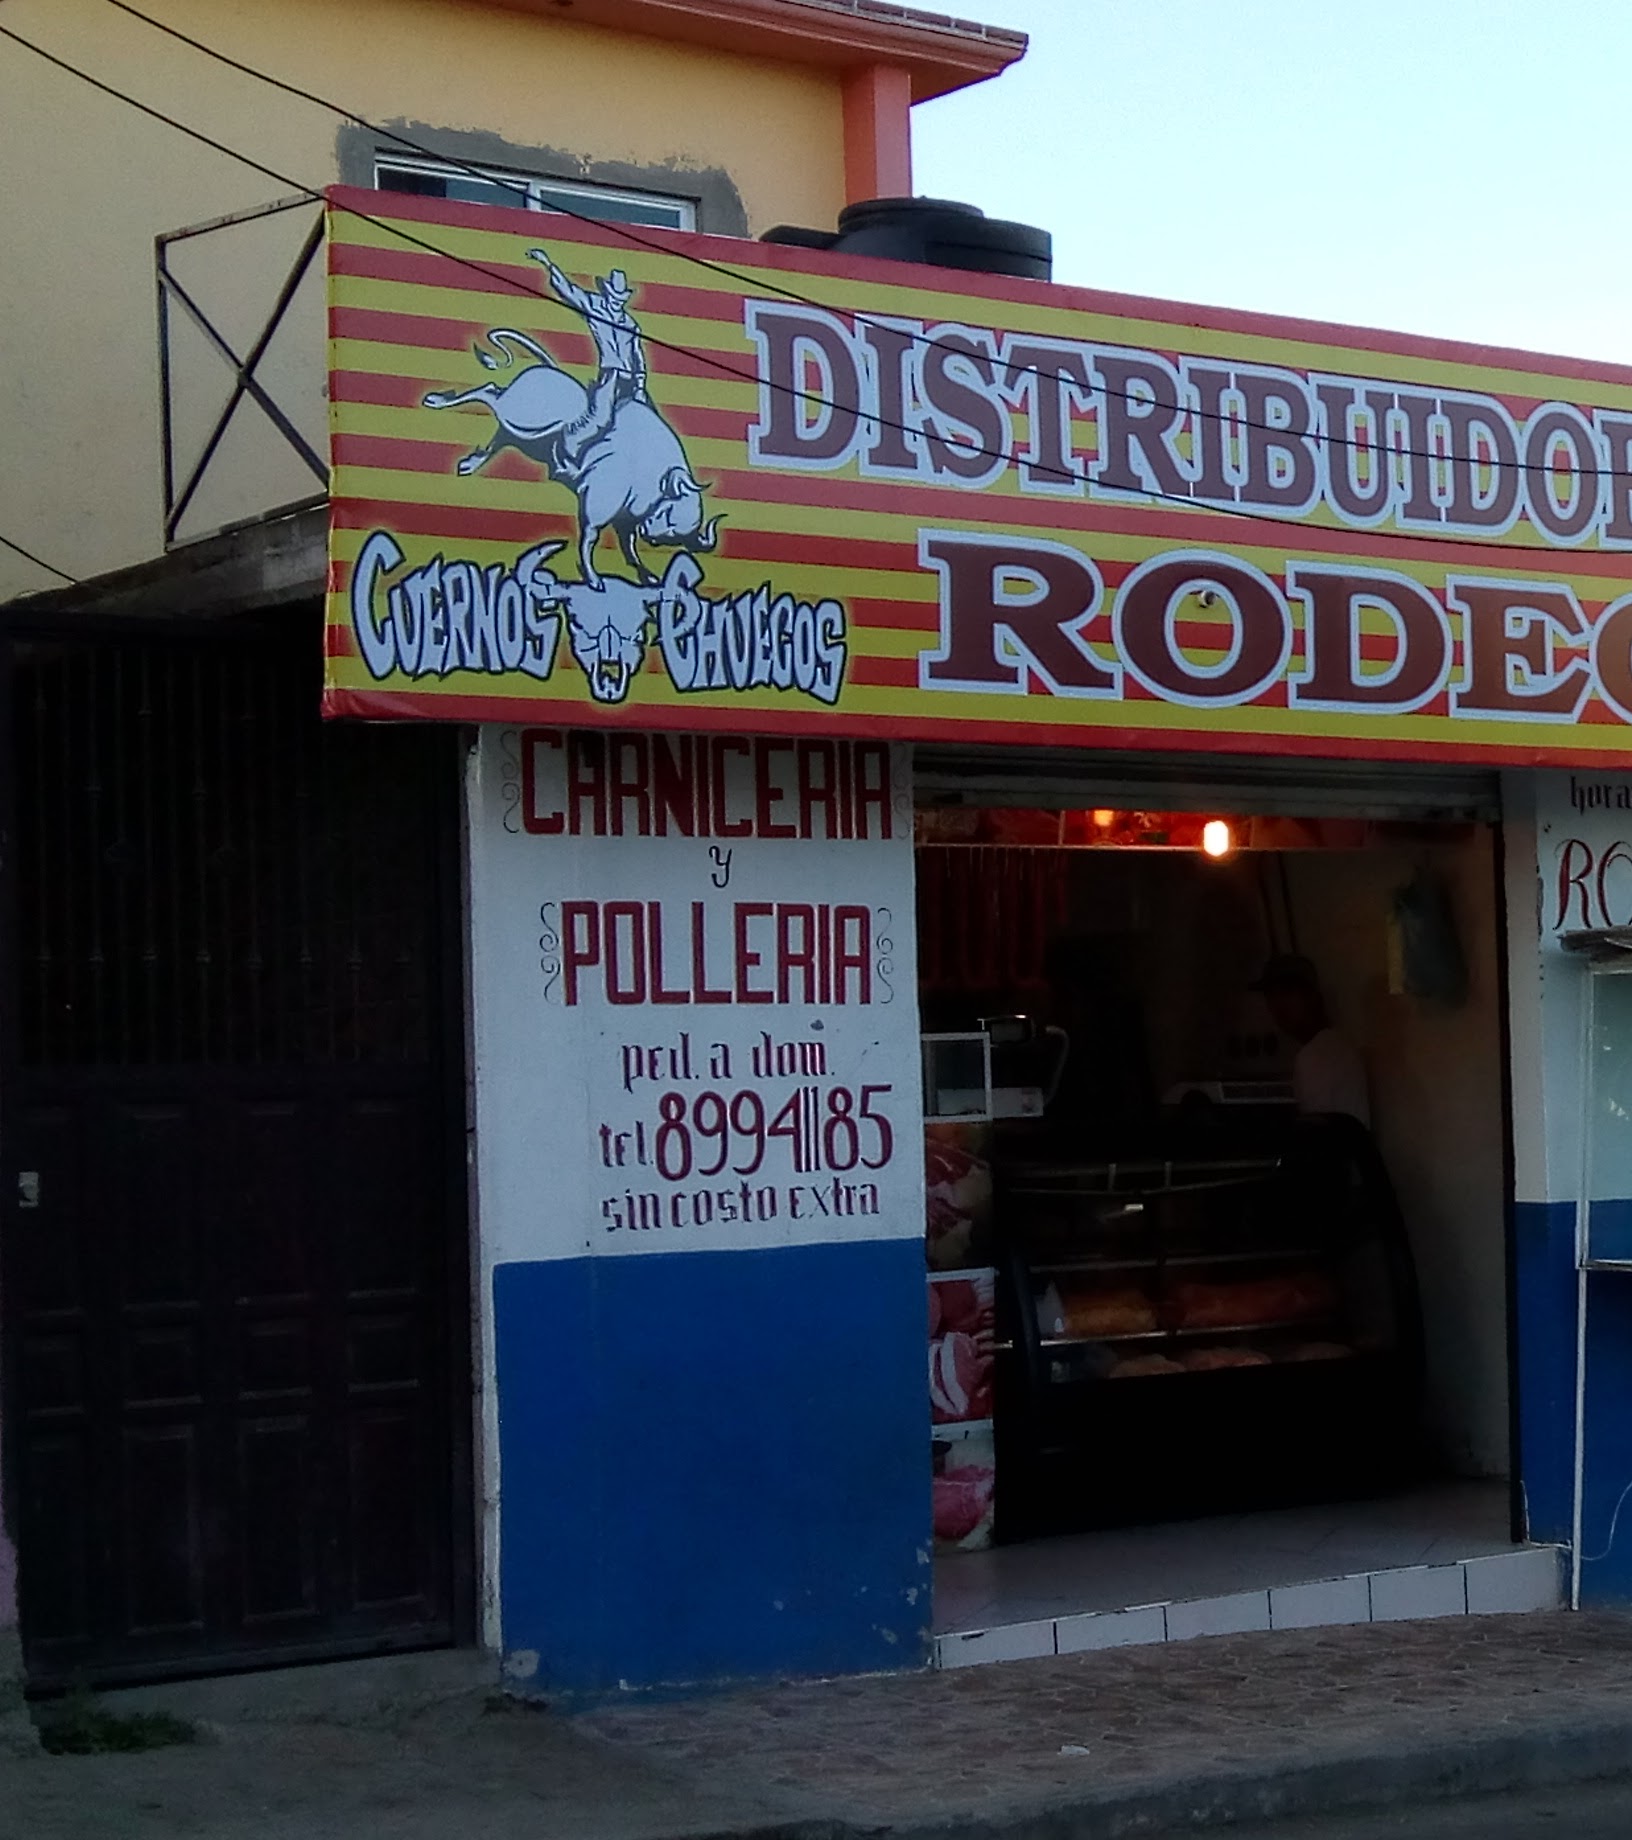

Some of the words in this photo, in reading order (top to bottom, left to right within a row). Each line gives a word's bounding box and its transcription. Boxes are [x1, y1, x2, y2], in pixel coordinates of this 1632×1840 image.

[521, 728, 892, 840] CARNICERIA
[560, 901, 872, 1006] POLLERIA
[710, 1042, 733, 1080] a
[655, 1084, 893, 1182] 89941185
[602, 1188, 662, 1232] sin
[671, 1180, 777, 1229] costo
[789, 1176, 880, 1220] extra
